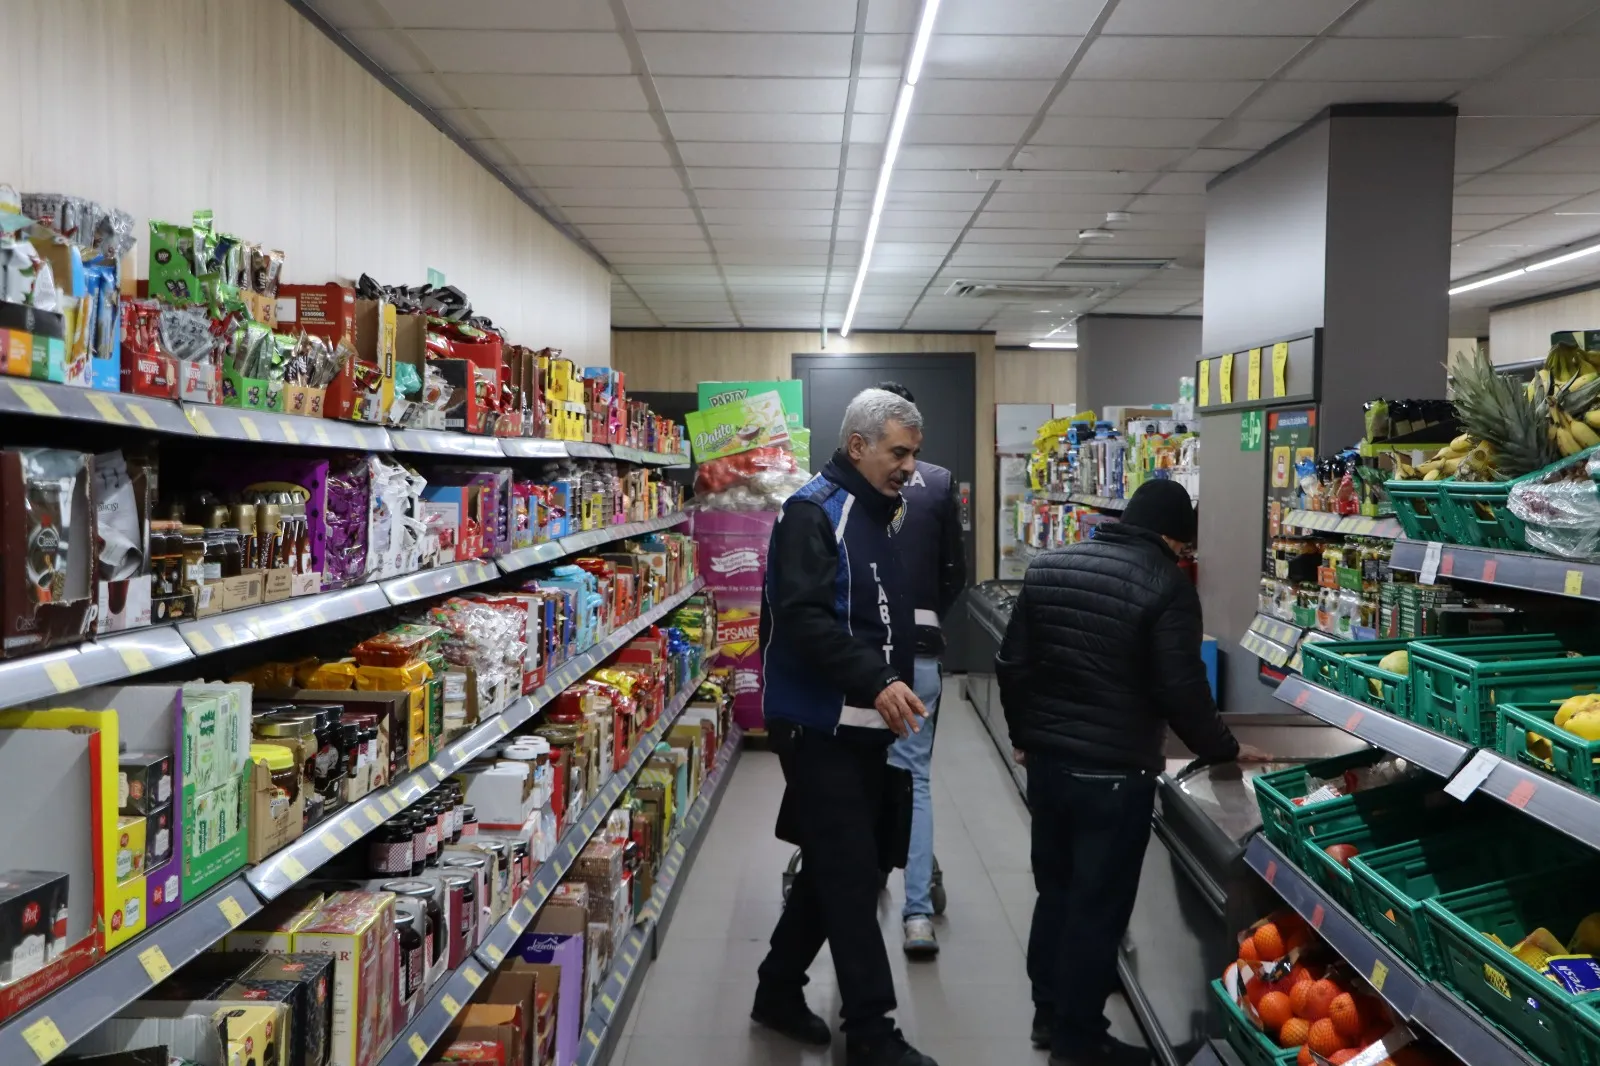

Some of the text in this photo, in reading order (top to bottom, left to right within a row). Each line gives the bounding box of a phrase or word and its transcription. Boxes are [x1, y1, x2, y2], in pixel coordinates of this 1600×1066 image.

[708, 389, 748, 408] PARTY
[695, 423, 732, 451] Patito
[716, 623, 759, 642] EFSANE
